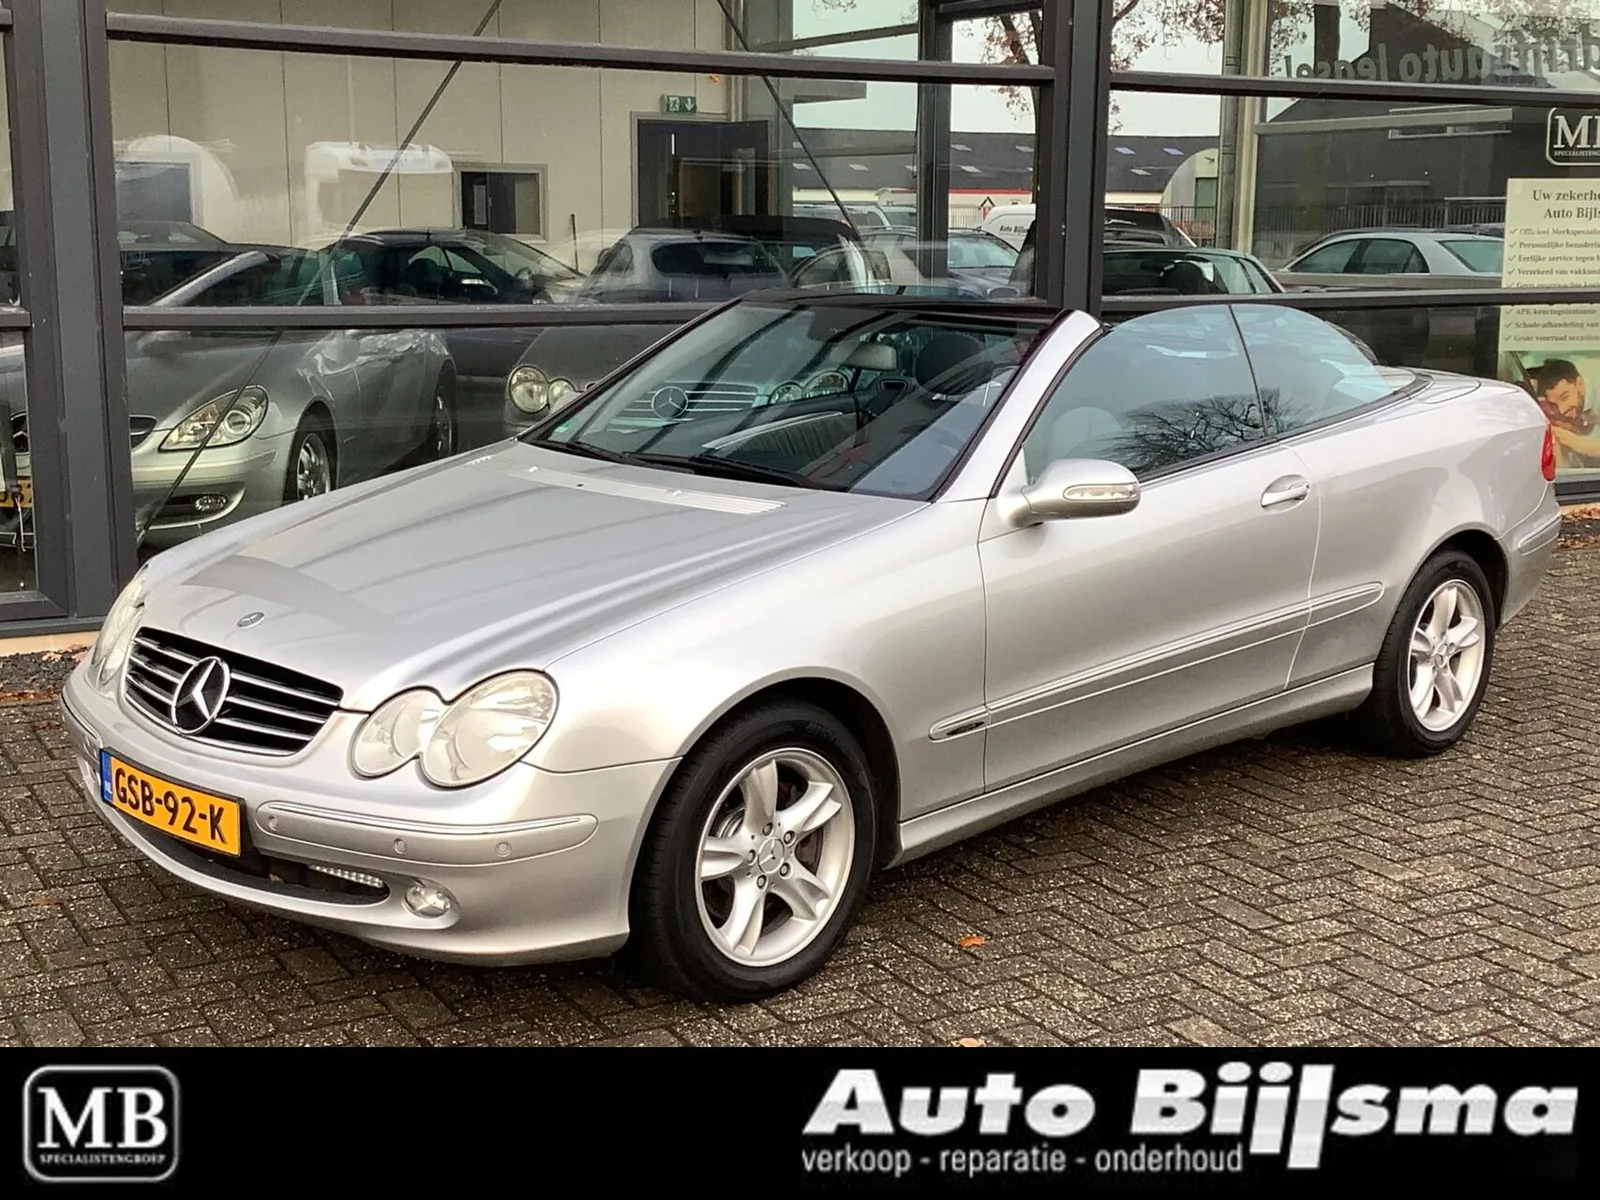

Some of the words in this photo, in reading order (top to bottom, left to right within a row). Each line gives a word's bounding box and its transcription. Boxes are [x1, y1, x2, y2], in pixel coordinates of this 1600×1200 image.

[1533, 189, 1552, 201] Uw
[1543, 207, 1573, 219] Auto
[1518, 254, 1547, 263] Eerlijke
[1517, 267, 1554, 276] Verzekerd
[115, 767, 228, 844] GSB-92-K
